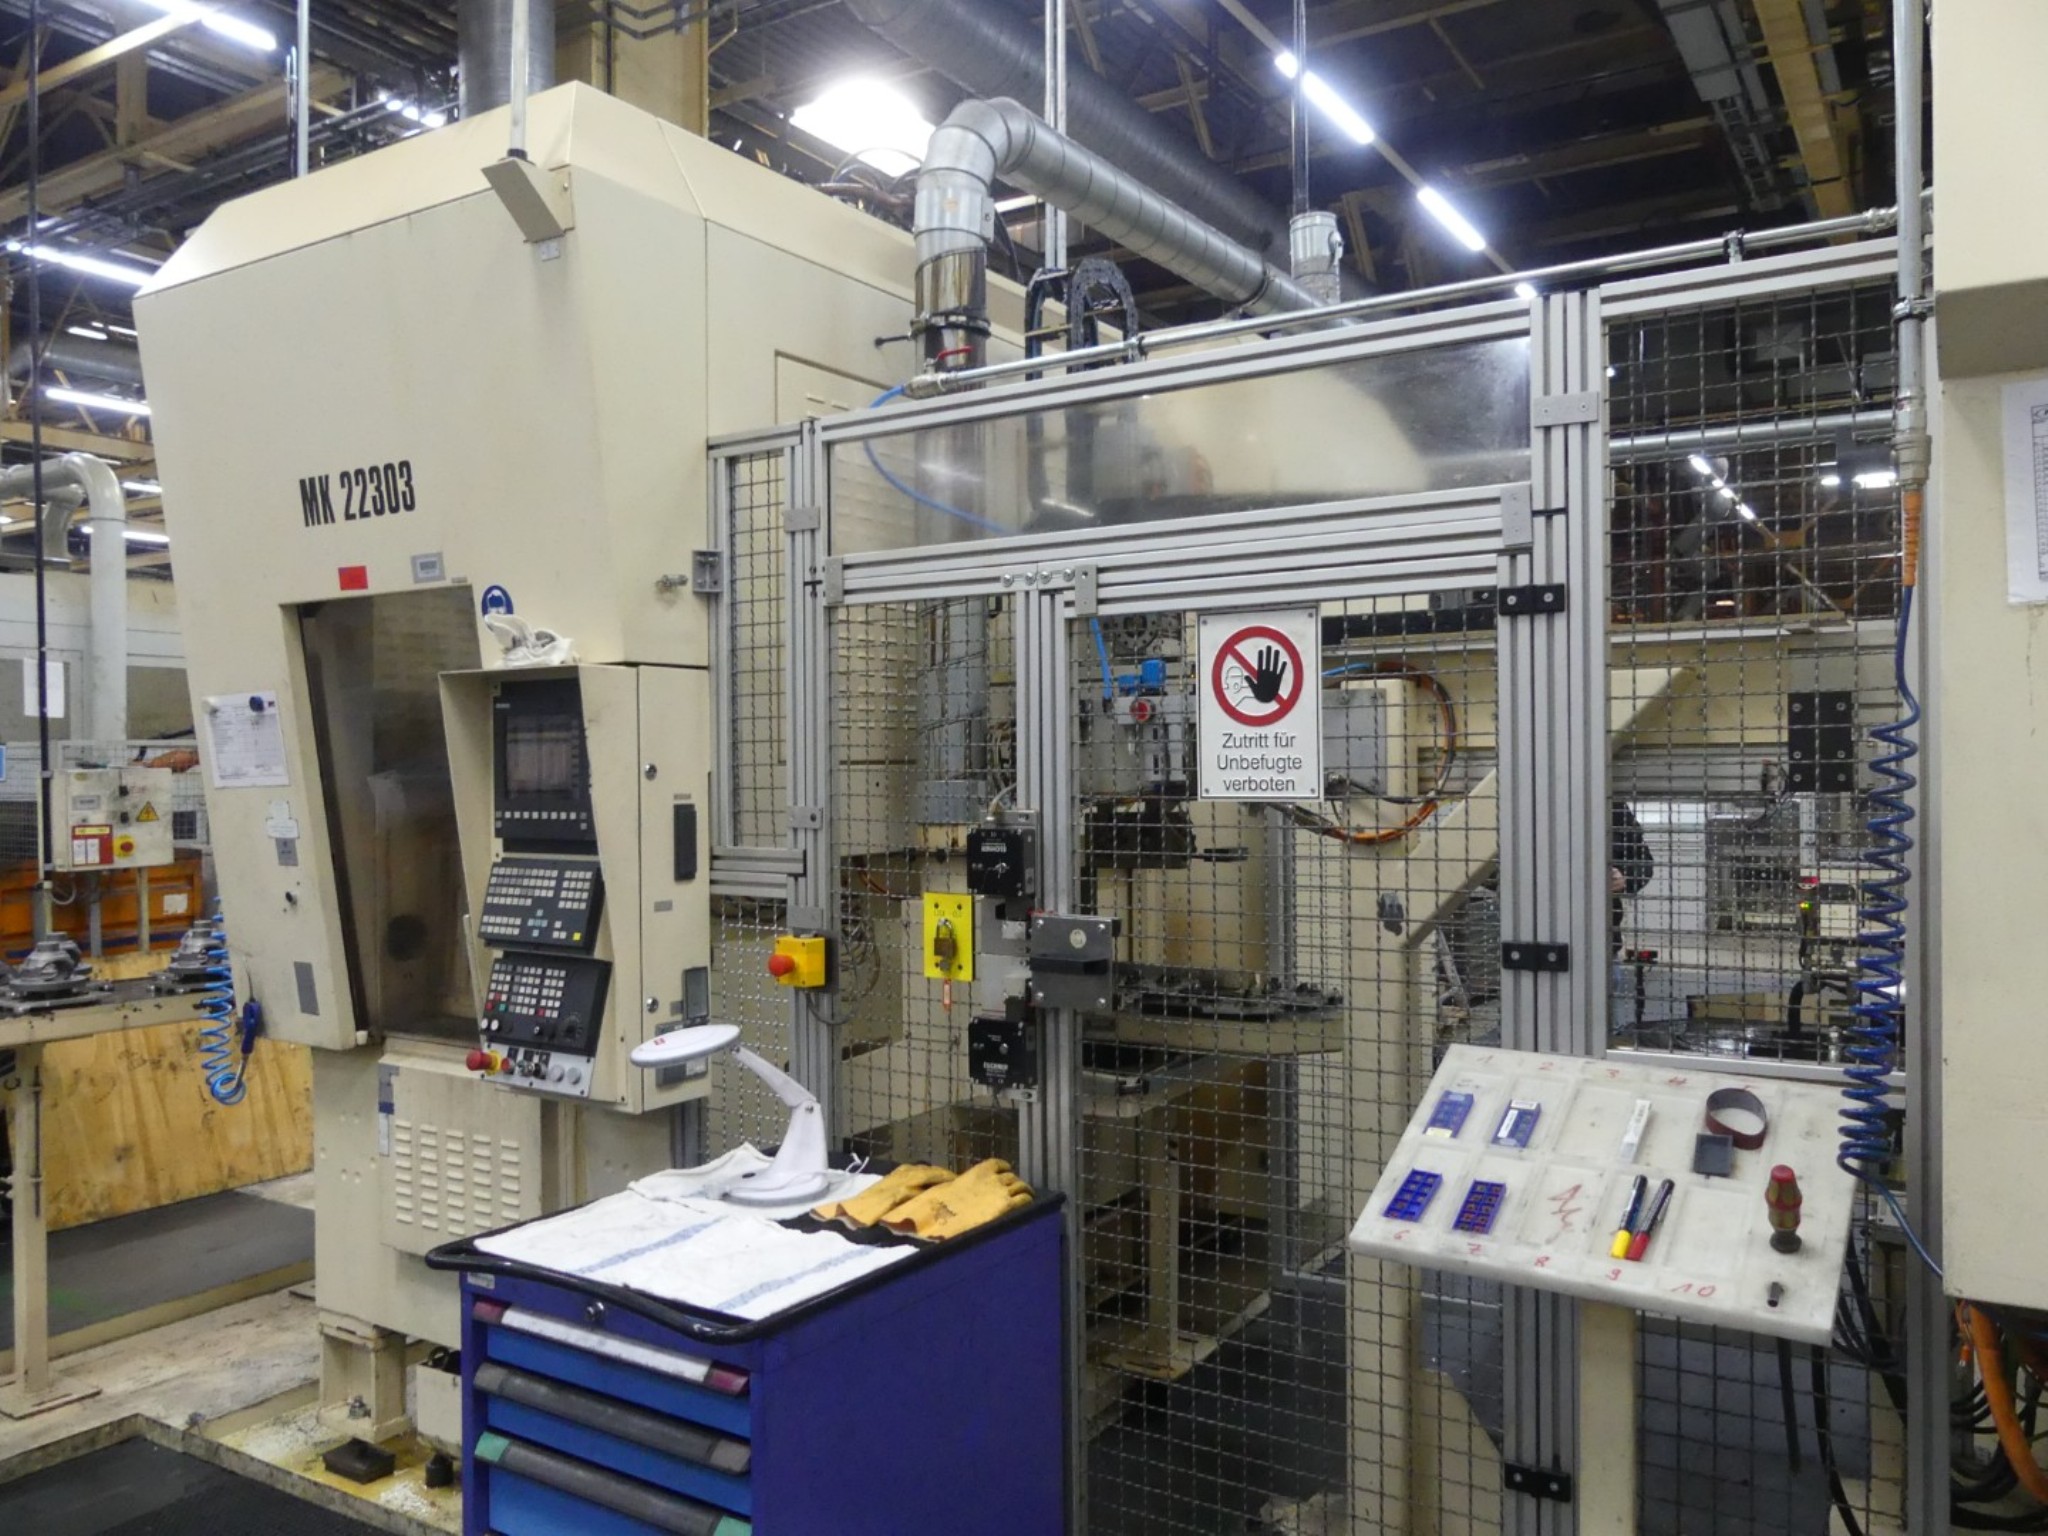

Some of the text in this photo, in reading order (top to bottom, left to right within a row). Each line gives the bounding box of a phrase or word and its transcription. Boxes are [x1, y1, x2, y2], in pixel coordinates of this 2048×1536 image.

[299, 460, 416, 527] MK 22303
[1222, 732, 1297, 749] Zutritt für
[1218, 754, 1302, 774] Unbefugte
[1223, 776, 1295, 792] verboten
[1537, 1062, 1554, 1071] 2
[1606, 1069, 1621, 1079] 3
[1606, 1268, 1623, 1281] 9
[1671, 1283, 1716, 1297] 10
